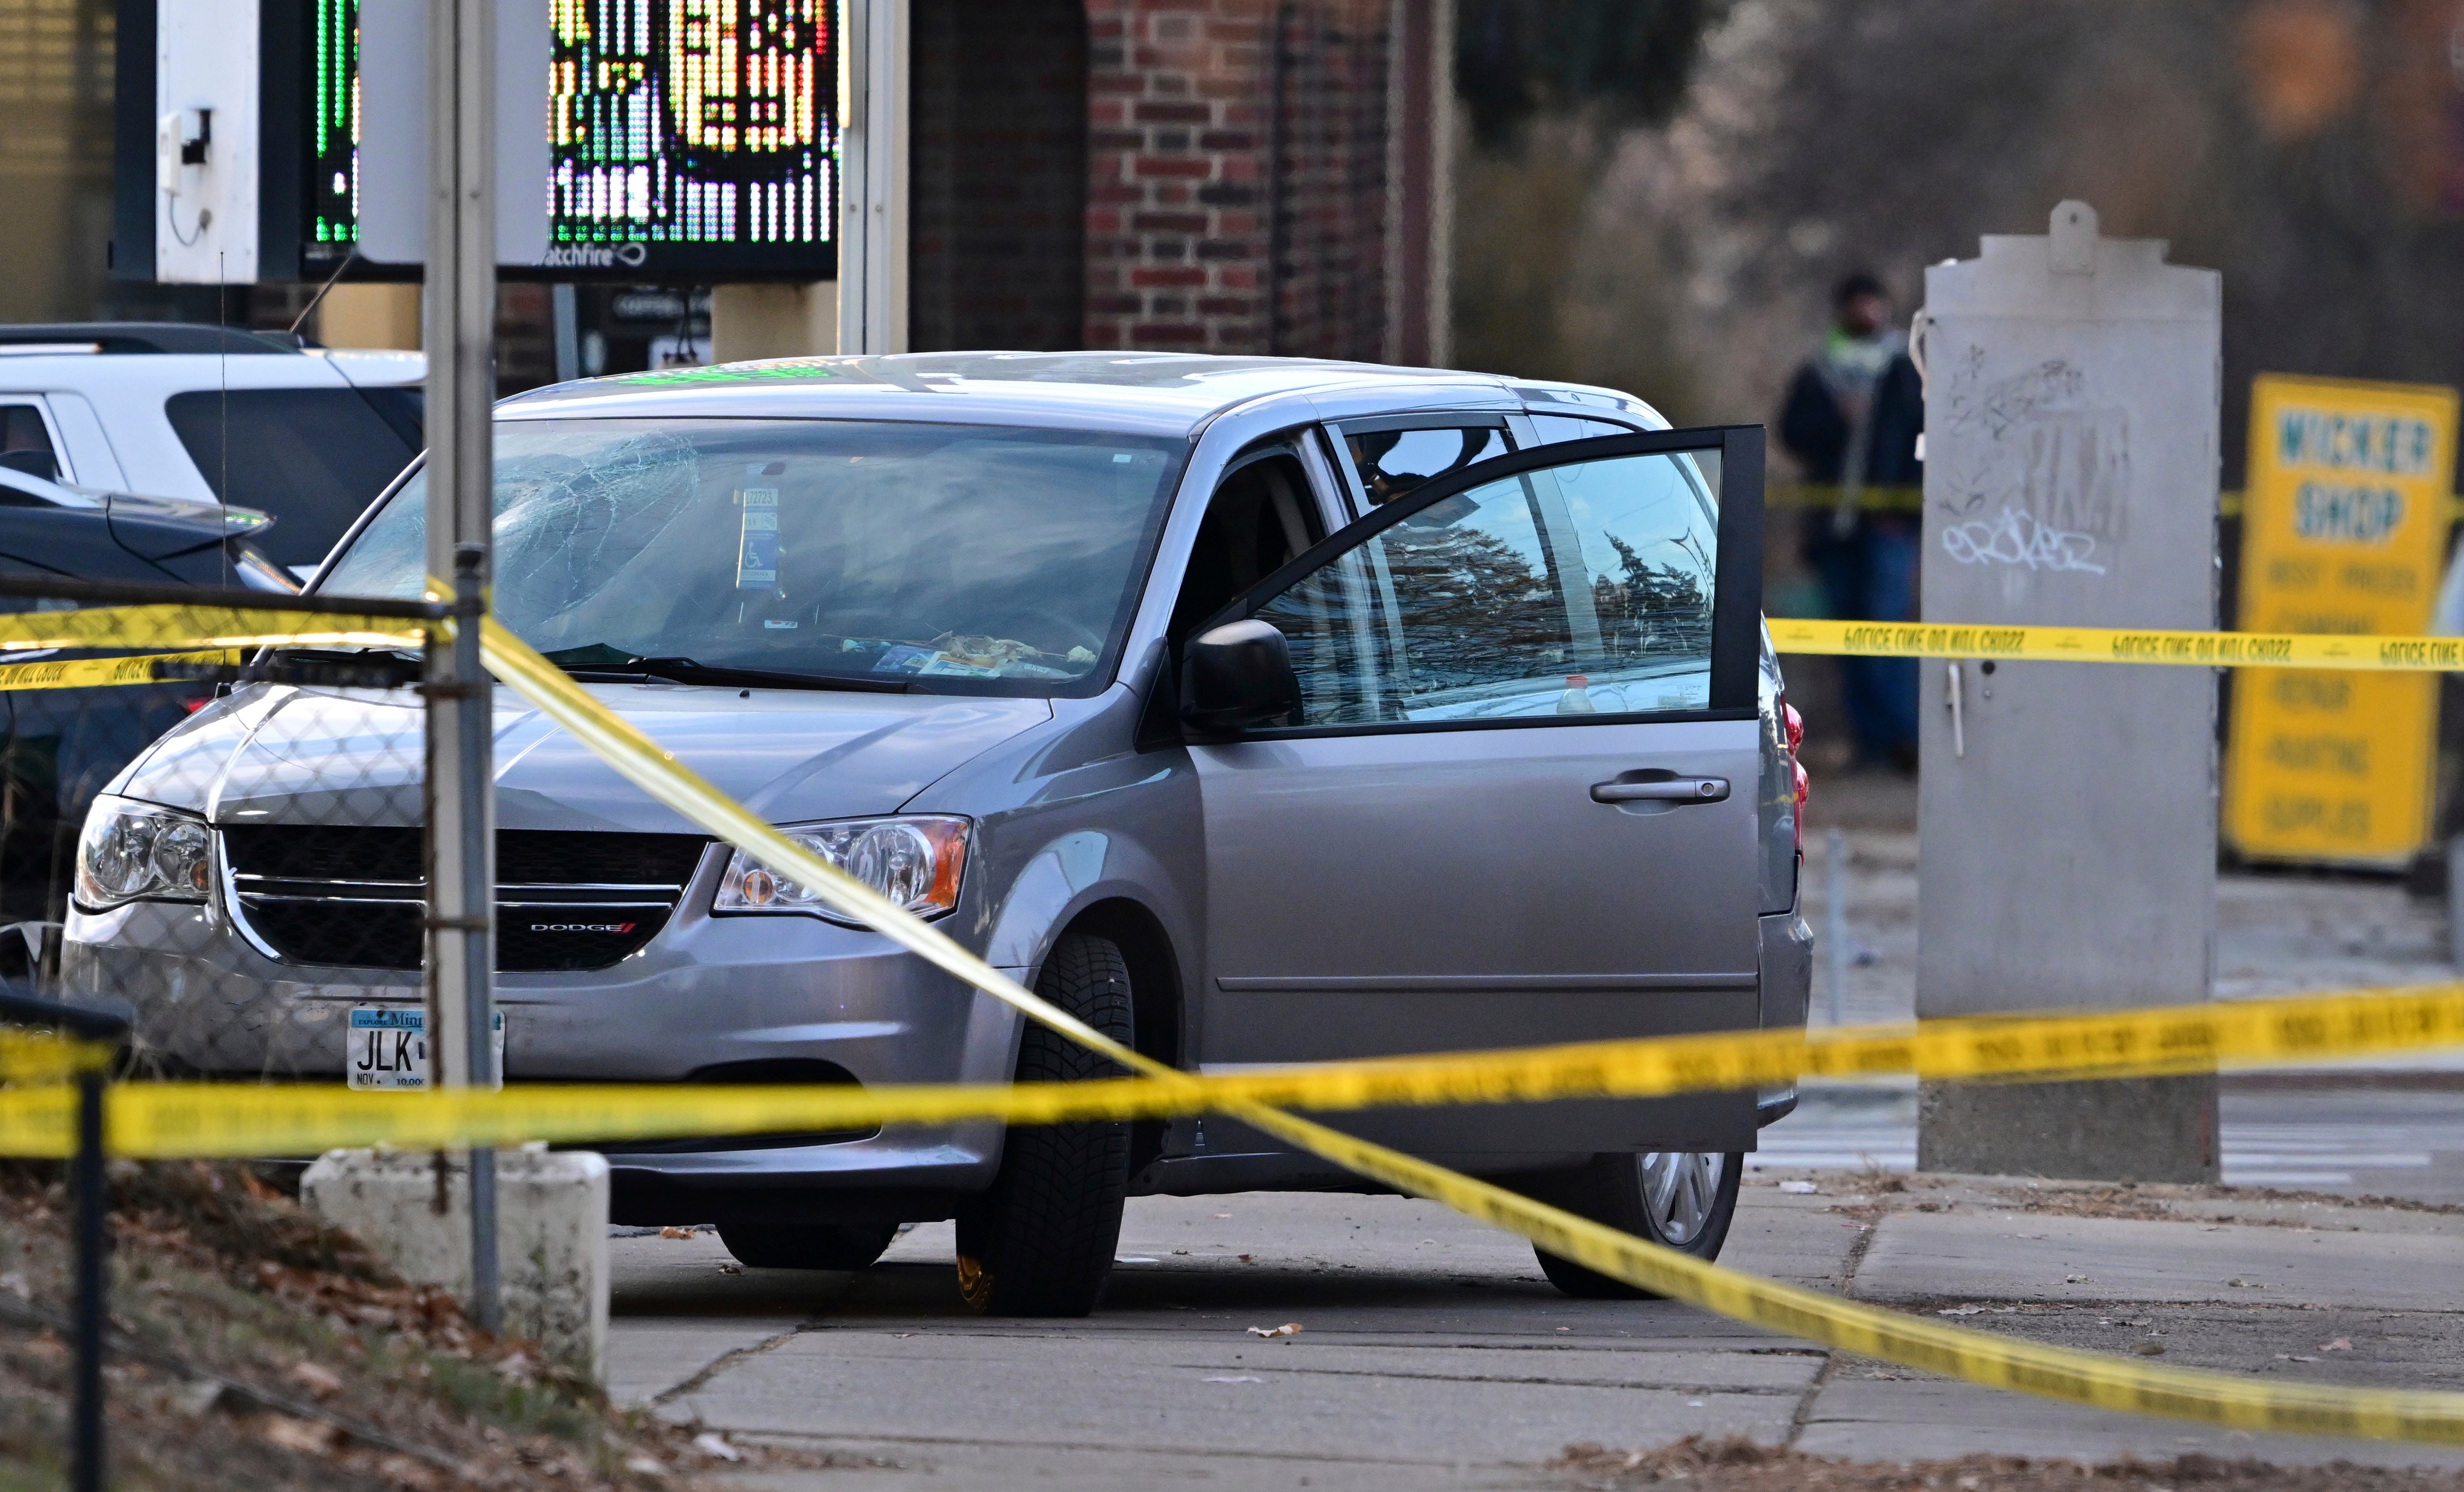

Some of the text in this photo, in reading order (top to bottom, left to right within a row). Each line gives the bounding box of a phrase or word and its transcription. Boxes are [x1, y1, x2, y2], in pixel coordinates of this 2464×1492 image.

[536, 243, 613, 267] atchfire
[2279, 411, 2431, 473] WICKER
[2294, 481, 2402, 540] SHOP
[357, 1031, 412, 1071] JLK
[357, 1073, 373, 1085] NOV
